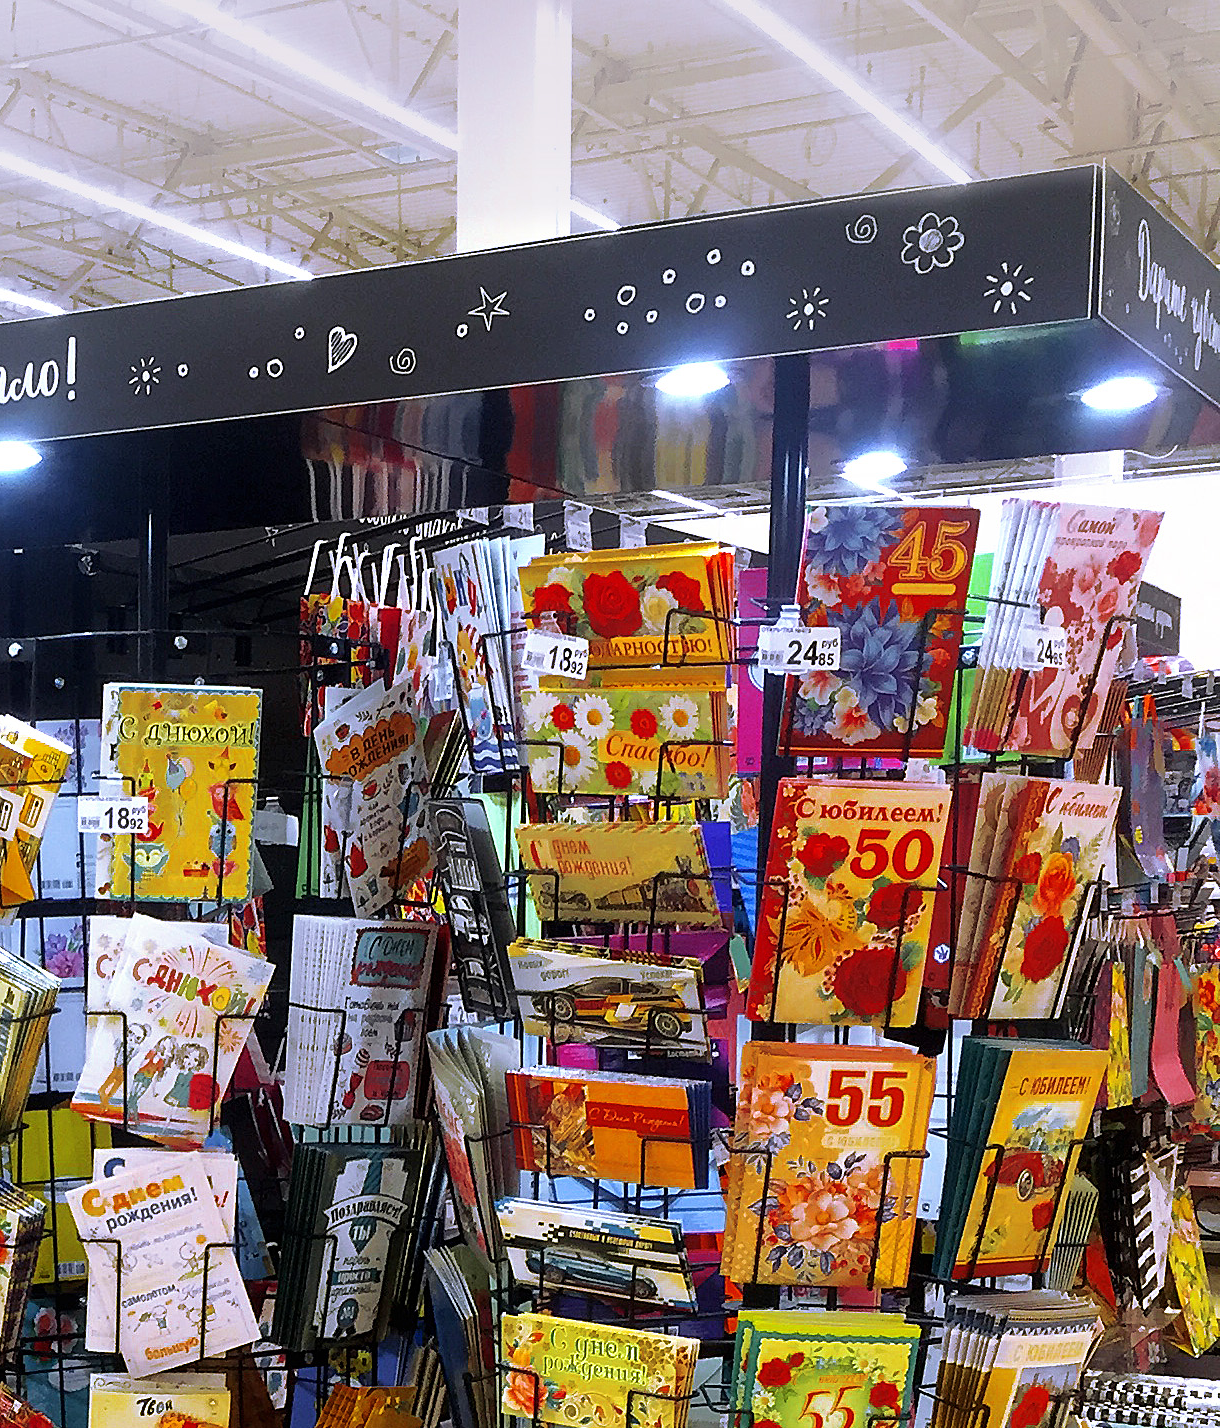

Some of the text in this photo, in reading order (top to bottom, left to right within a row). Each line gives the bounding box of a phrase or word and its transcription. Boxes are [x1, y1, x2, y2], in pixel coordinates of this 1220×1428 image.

[888, 520, 970, 581] 45
[549, 645, 573, 672] 18
[787, 637, 838, 666] 24 руб
[818, 653, 834, 666] 85
[1036, 638, 1054, 664] 24
[570, 661, 584, 675] 92
[120, 716, 136, 740] С
[364, 726, 395, 753] ДЕНЬ
[345, 733, 409, 777] ОЖДЕНИЯ!
[105, 807, 129, 829] 18
[130, 818, 144, 829] 92
[797, 798, 944, 822] С юбилеем!
[850, 828, 934, 881] 50
[132, 958, 151, 981] С
[826, 1070, 907, 1127] 55
[1019, 1075, 1091, 1096] С ЮБИЛЕЕМ!
[82, 1188, 106, 1217] С
[112, 1175, 185, 1214] днем
[106, 1187, 198, 1233] рождения!
[550, 1326, 641, 1362] С днем
[542, 1353, 647, 1385] рождения!
